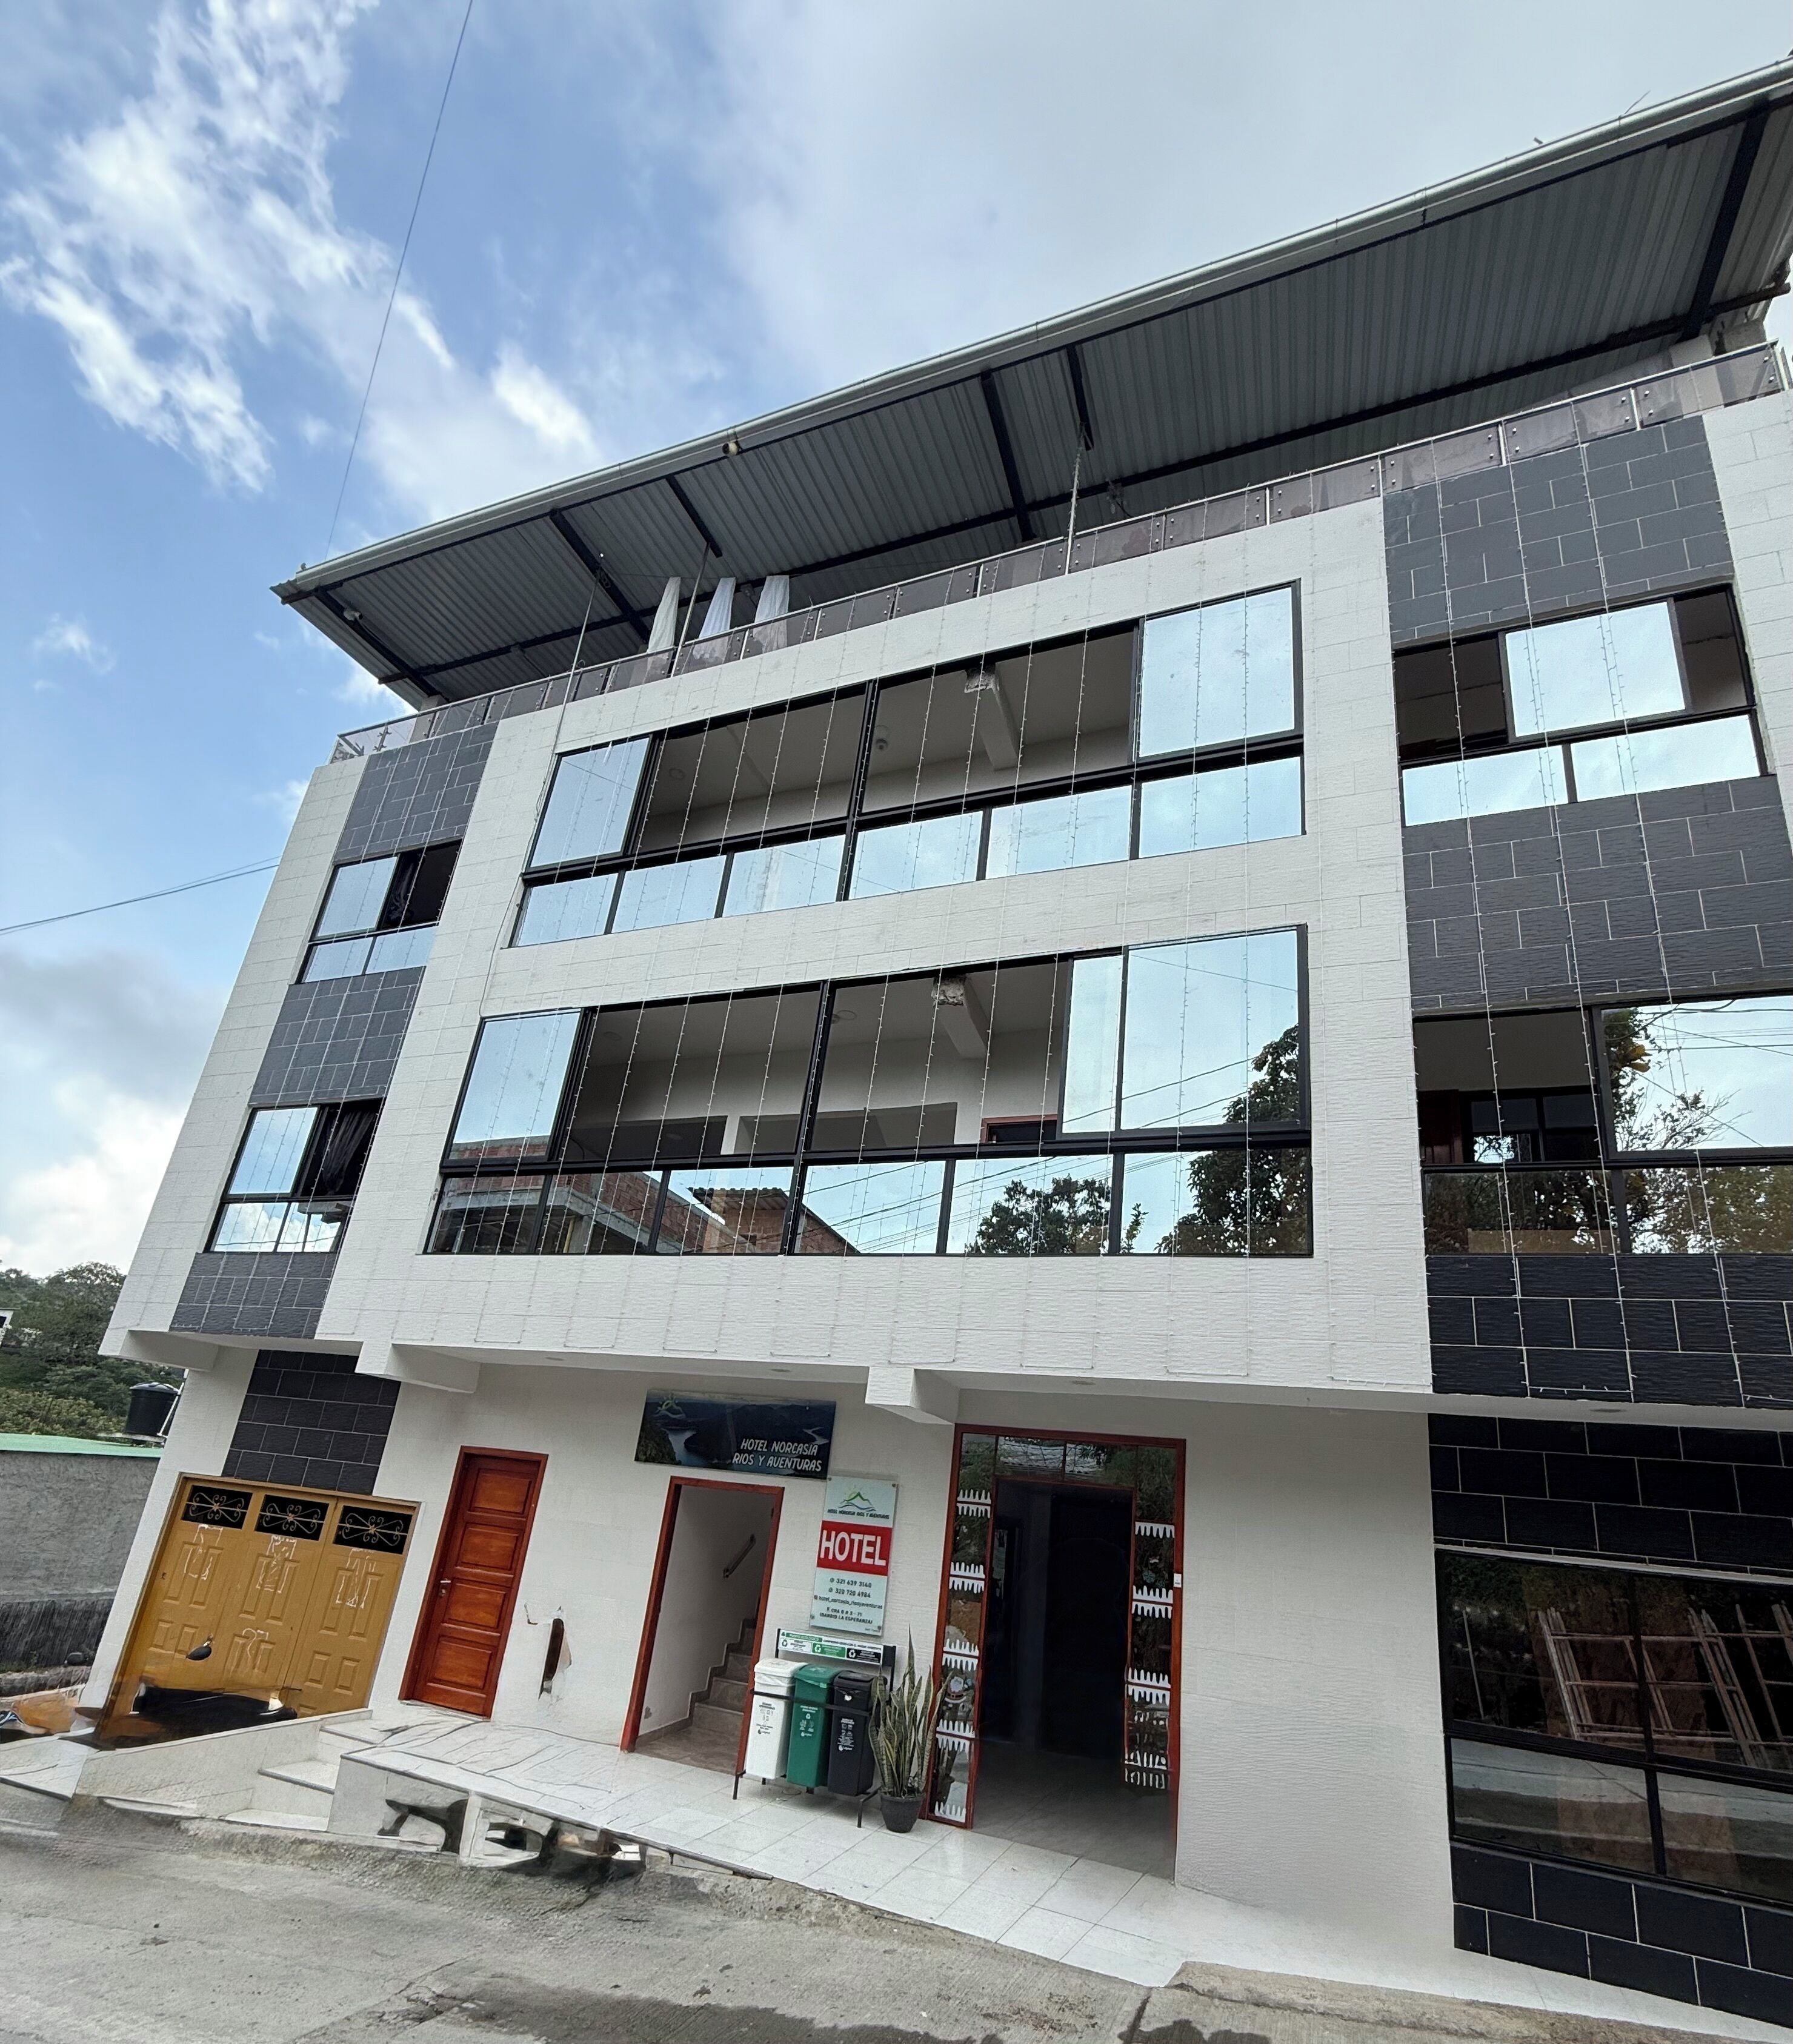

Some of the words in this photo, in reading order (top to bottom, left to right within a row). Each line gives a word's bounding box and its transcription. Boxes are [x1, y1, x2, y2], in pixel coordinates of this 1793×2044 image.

[740, 1438, 768, 1452] HOTEL
[771, 1441, 818, 1456] NORCASIA
[732, 1452, 754, 1465] RIOS
[758, 1455, 765, 1466] Y
[766, 1456, 822, 1472] AVENTURAS
[820, 1530, 886, 1566] HOTEL
